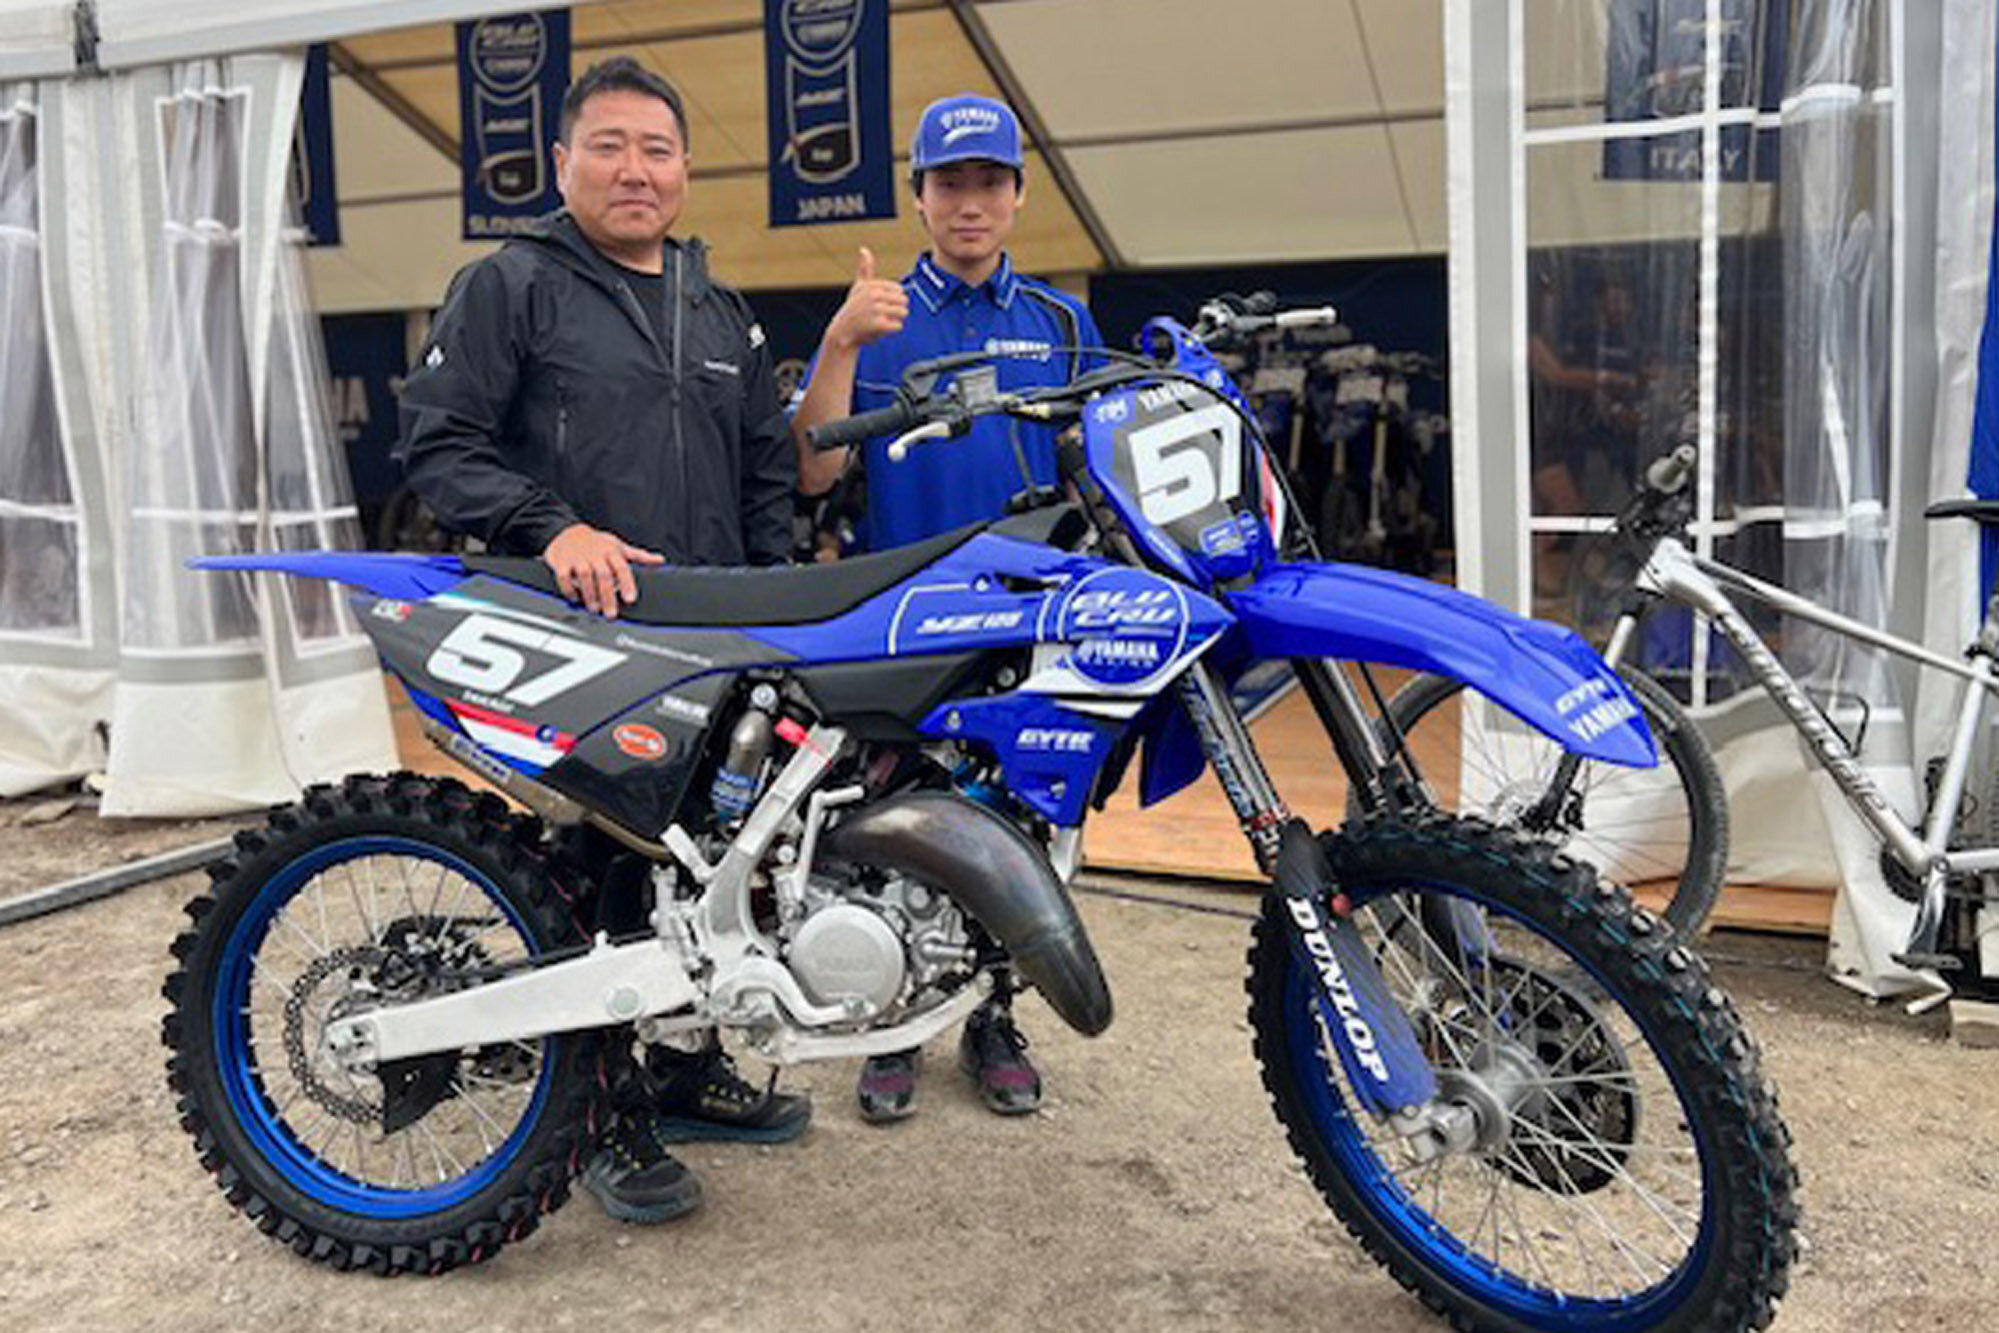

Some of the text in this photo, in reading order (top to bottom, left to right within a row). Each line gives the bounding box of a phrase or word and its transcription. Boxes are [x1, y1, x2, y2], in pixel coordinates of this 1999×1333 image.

[1651, 147, 1741, 172] ITAY
[798, 194, 865, 219] JAPAN
[1128, 402, 1243, 526] 57
[426, 612, 629, 707] 57
[1015, 728, 1096, 752] GYTR
[1286, 896, 1389, 1082] DUNLOP
